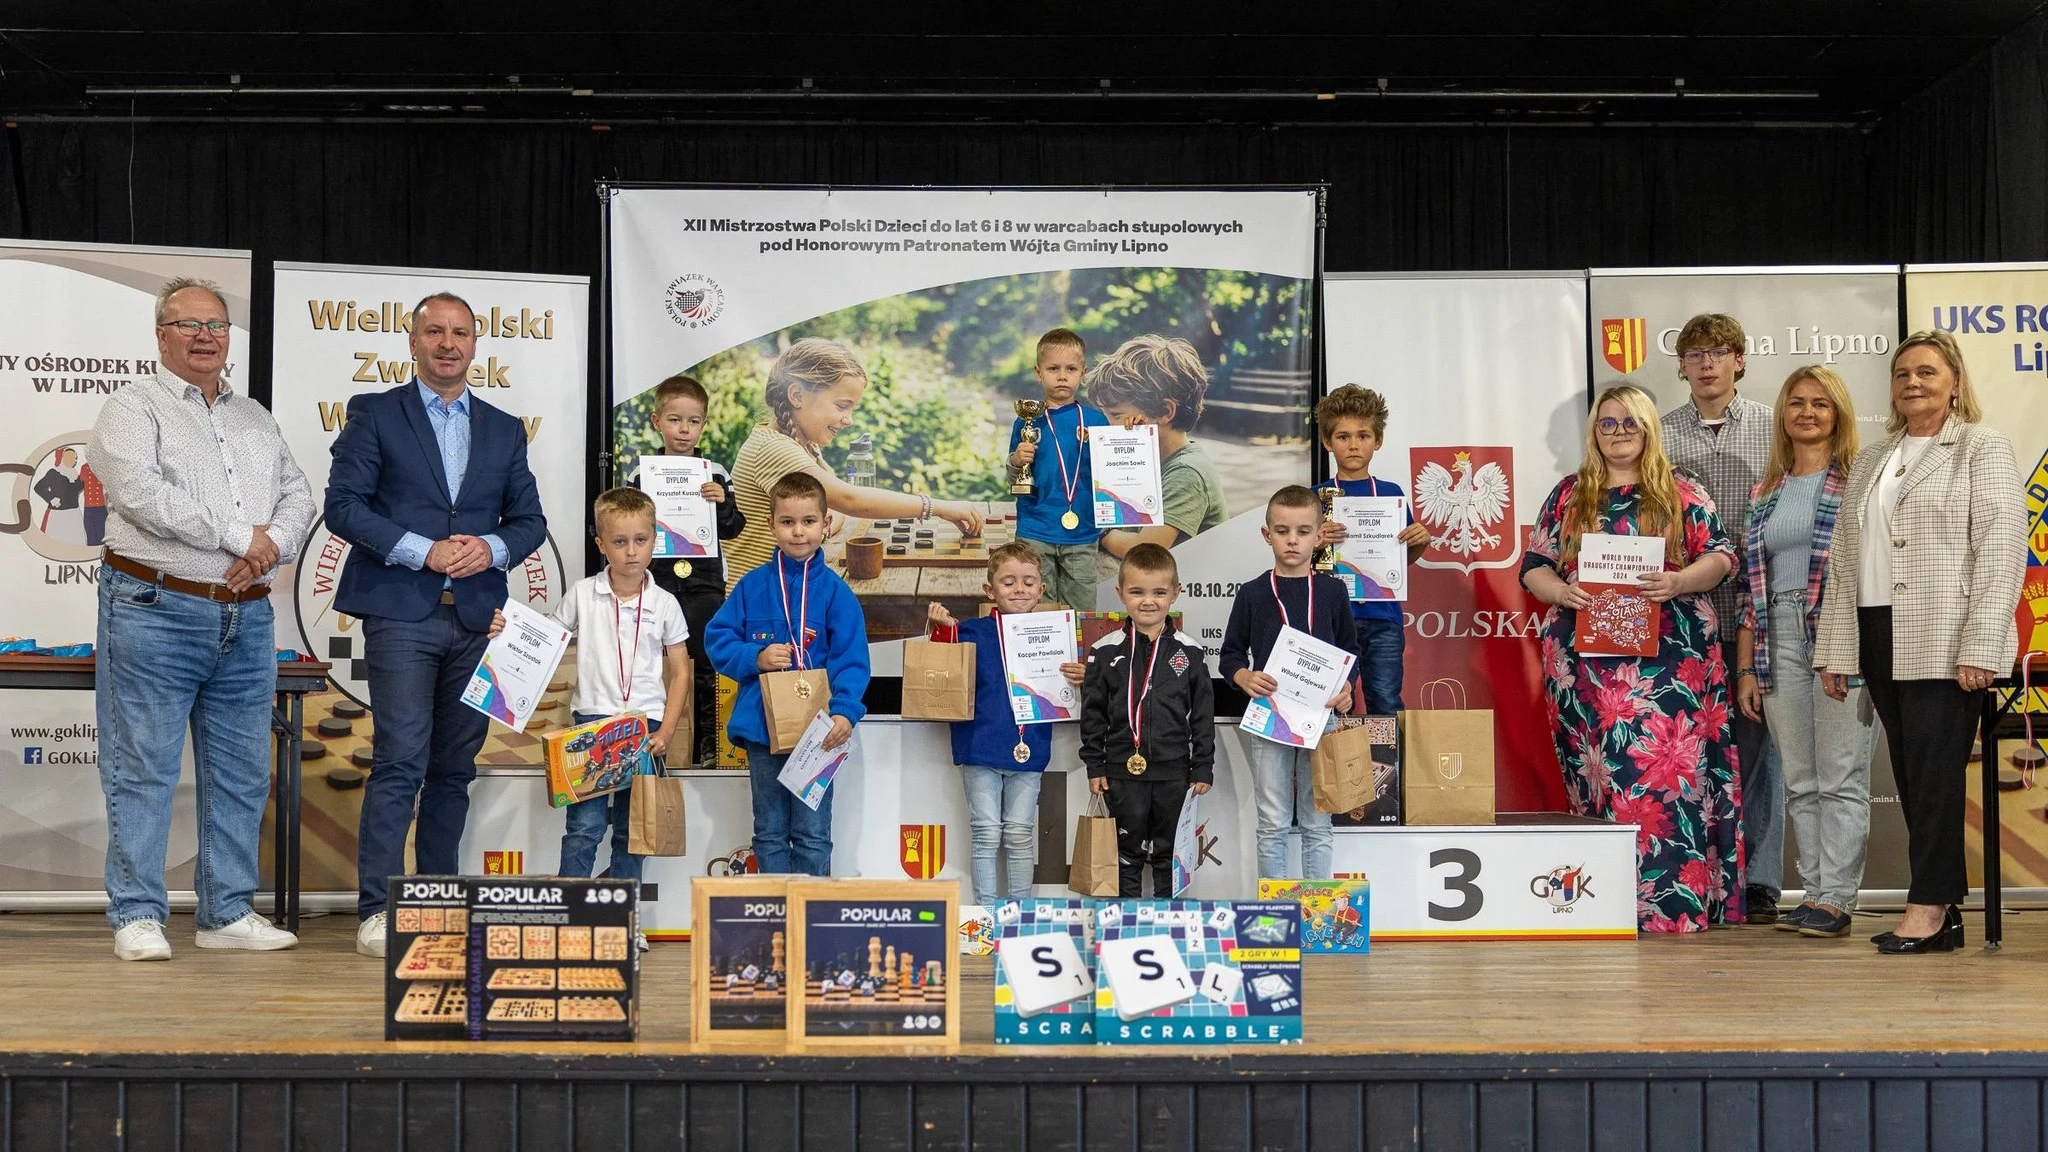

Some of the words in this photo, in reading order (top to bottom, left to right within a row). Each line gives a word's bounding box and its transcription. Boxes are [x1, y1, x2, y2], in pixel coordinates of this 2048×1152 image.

[683, 219, 707, 232] XII
[710, 219, 816, 232] Mistrzostwa
[819, 219, 872, 232] Polski
[875, 219, 927, 233] Dzieci
[930, 219, 951, 233] do
[955, 219, 977, 233] lat
[981, 219, 991, 233] 6
[994, 219, 999, 232] i
[1002, 219, 1013, 232] 8
[1016, 222, 1033, 232] w
[1034, 220, 1129, 233] warcabach
[1131, 220, 1243, 236] stupolowych
[760, 239, 792, 253] pod
[796, 239, 900, 254] Honorowym
[903, 239, 1007, 251] Patronatem
[1010, 238, 1061, 255] Wójta
[1063, 239, 1119, 255] Gminy
[1121, 239, 1169, 253] Lipno
[308, 299, 554, 340] Wielkolski
[1933, 304, 2006, 334] UKS
[1785, 325, 1890, 365] Lipno
[24, 352, 130, 375] OŚRODEK
[2013, 342, 2048, 379] Li
[352, 352, 511, 388] Zwiek
[32, 377, 55, 393] W
[1113, 446, 1135, 454] DYPLOM
[665, 476, 689, 484] DYPLOM
[656, 490, 681, 498] Krzysztof
[1358, 518, 1381, 527] DYPLOM
[1583, 561, 1614, 570] DRAUGHTS
[1615, 563, 1660, 572] CHAMPIONSHIP
[1601, 553, 1622, 561] WORLD
[1623, 555, 1643, 563] YOUTH
[1606, 601, 1645, 619] POLAND
[519, 631, 542, 649] DYPLOM
[1027, 635, 1051, 644] DYPLOM
[1201, 628, 1222, 639] UKS
[1017, 652, 1038, 660] Kacper
[1296, 657, 1321, 673] DYPLOM
[1280, 666, 1299, 680] Witold
[1299, 675, 1327, 692] Gajewski
[48, 750, 99, 768] GOKLi
[1428, 847, 1485, 922] 3
[478, 886, 563, 903] POPULAR
[841, 908, 911, 922] POPULAR
[1031, 946, 1063, 978] S
[1132, 949, 1165, 981] S
[1120, 1025, 1280, 1038] SCRABBLE
